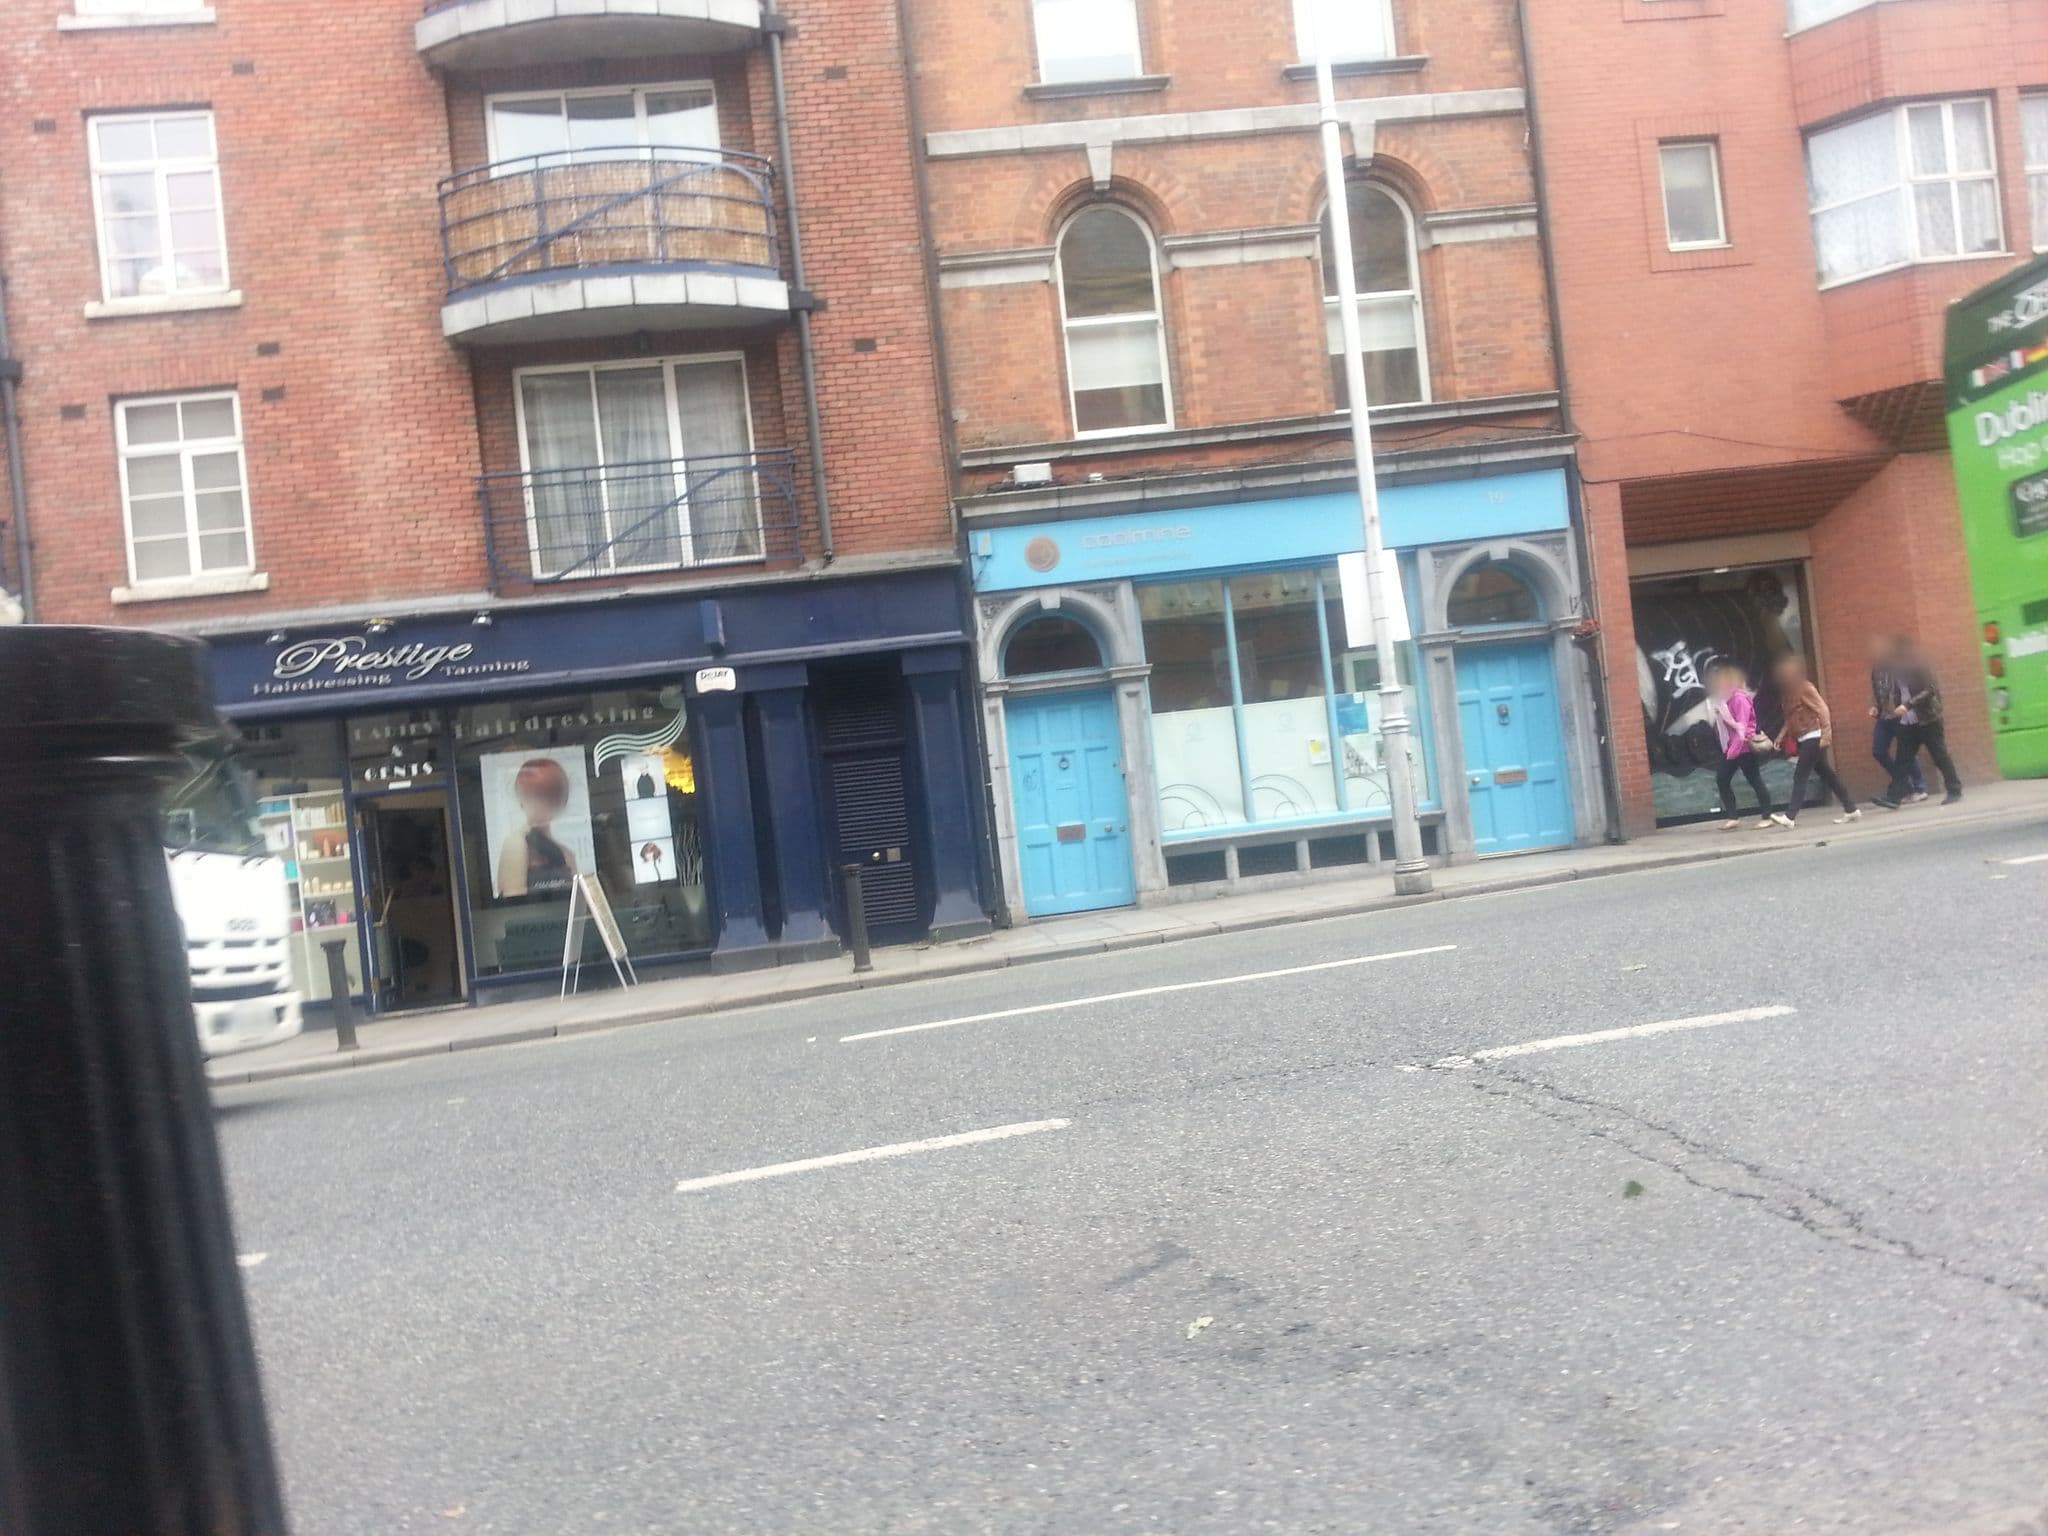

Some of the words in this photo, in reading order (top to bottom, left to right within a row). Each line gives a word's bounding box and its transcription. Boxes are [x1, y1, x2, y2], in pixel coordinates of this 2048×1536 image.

[273, 636, 473, 680] Prestige
[440, 661, 530, 676] Tanning
[253, 674, 392, 695] Hairdressing
[353, 720, 433, 741] LADIES
[364, 761, 433, 782] GENTS
